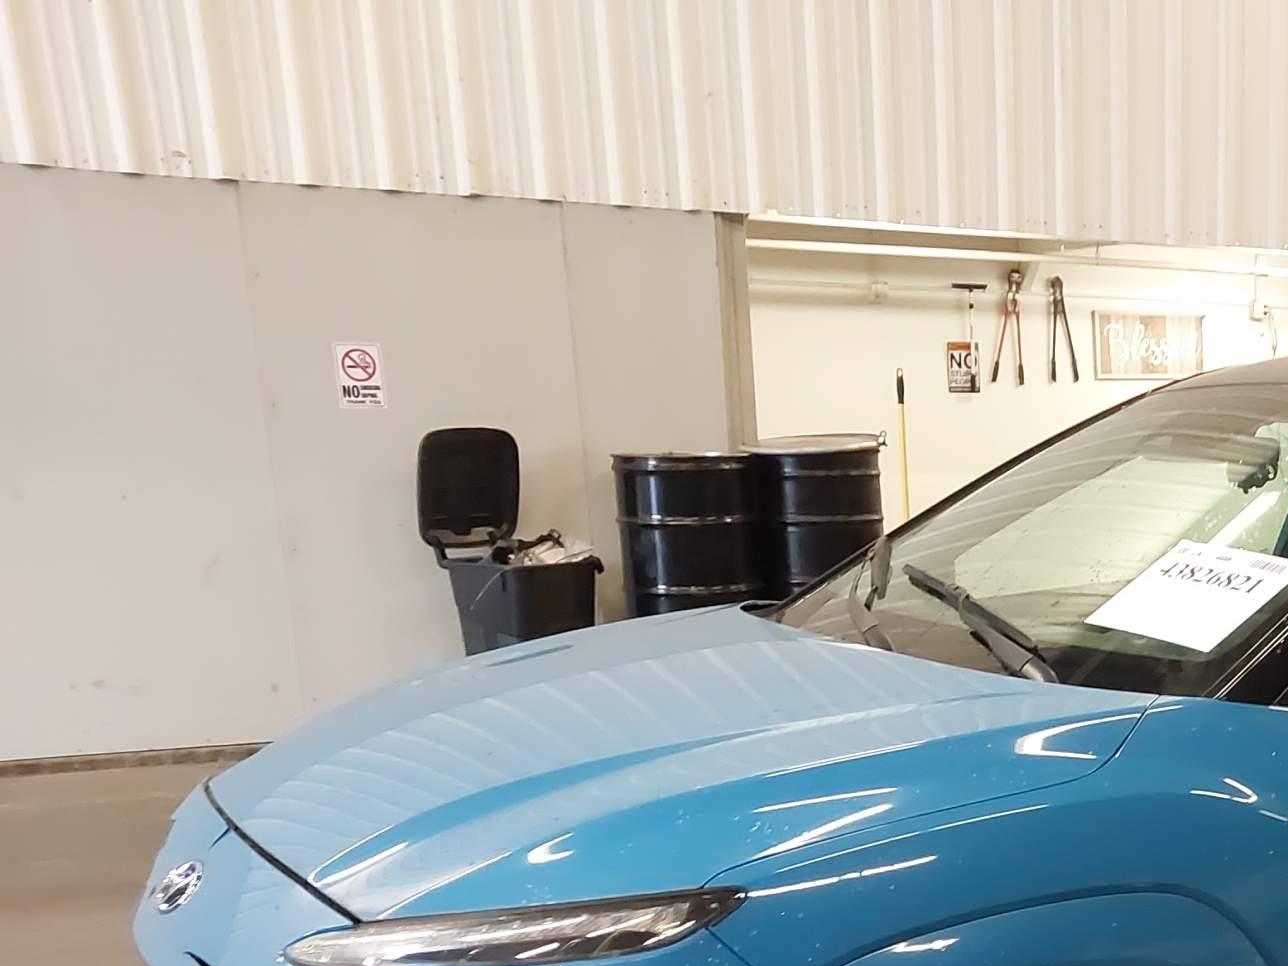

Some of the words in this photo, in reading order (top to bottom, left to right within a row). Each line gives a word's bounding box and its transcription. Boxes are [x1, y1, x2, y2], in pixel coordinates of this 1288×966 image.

[1104, 320, 1202, 366] Blessd
[950, 352, 977, 369] NO
[342, 385, 360, 398] NO
[1160, 561, 1265, 594] 43826821
